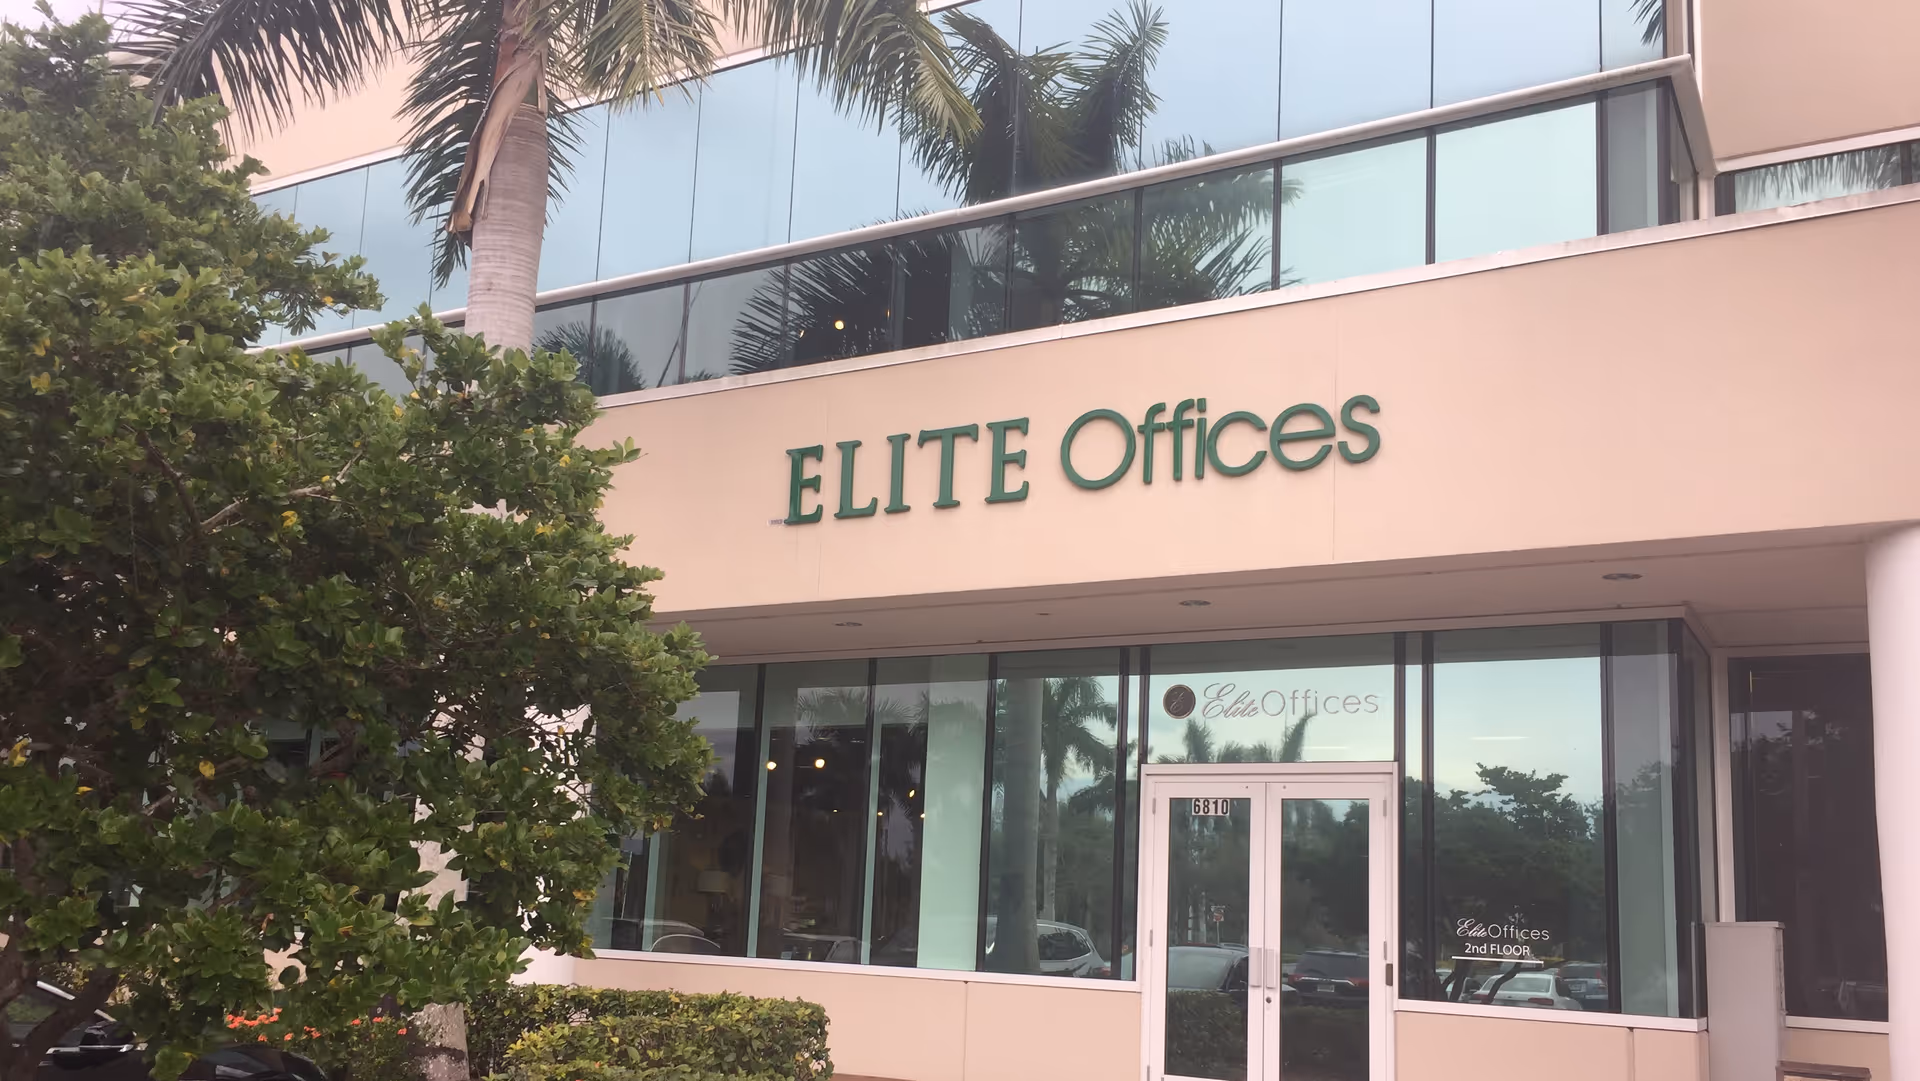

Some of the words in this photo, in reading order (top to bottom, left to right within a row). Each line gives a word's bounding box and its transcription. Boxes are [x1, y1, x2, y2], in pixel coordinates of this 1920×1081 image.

[784, 416, 1030, 525] ELITE
[1060, 394, 1381, 490] Offices
[1193, 799, 1229, 815] 6810
[1464, 942, 1487, 954] 2nd
[1490, 943, 1530, 956] FLOOR
